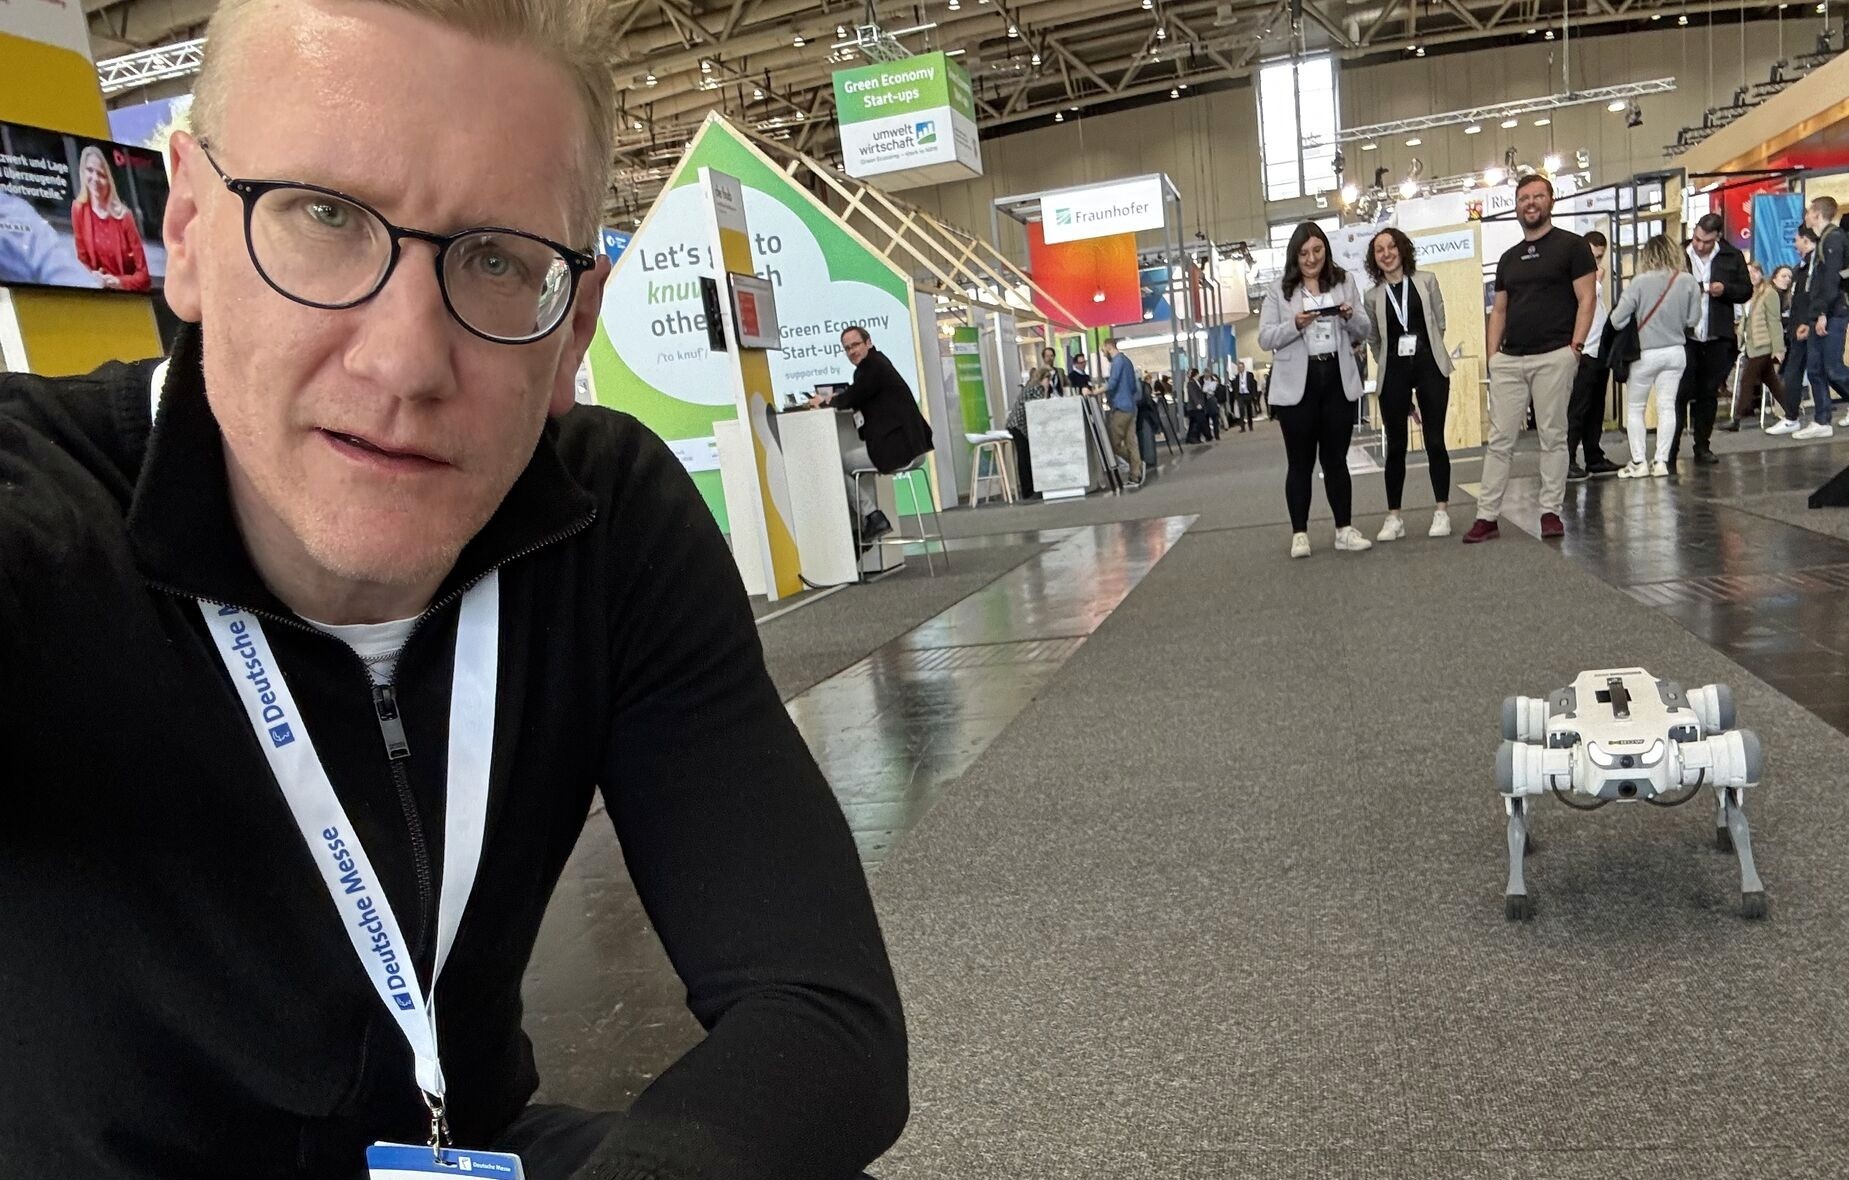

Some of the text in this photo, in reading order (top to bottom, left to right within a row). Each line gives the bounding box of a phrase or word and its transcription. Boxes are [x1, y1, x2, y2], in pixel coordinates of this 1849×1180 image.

[844, 79, 880, 94] Green
[881, 66, 935, 87] Economy
[863, 88, 920, 108] Start-ups
[872, 123, 914, 141] umwelt
[858, 136, 915, 155] wirtschaft
[1075, 202, 1149, 223] Fraunhofer
[754, 233, 782, 256] to
[1413, 238, 1470, 257] EXTWAVE
[651, 310, 708, 337] othe
[779, 315, 889, 339] Green Economy
[781, 343, 843, 361] Start-up
[784, 365, 841, 380] supported by
[229, 620, 285, 723] Deutsche
[322, 825, 407, 991] Deutsche Messe
